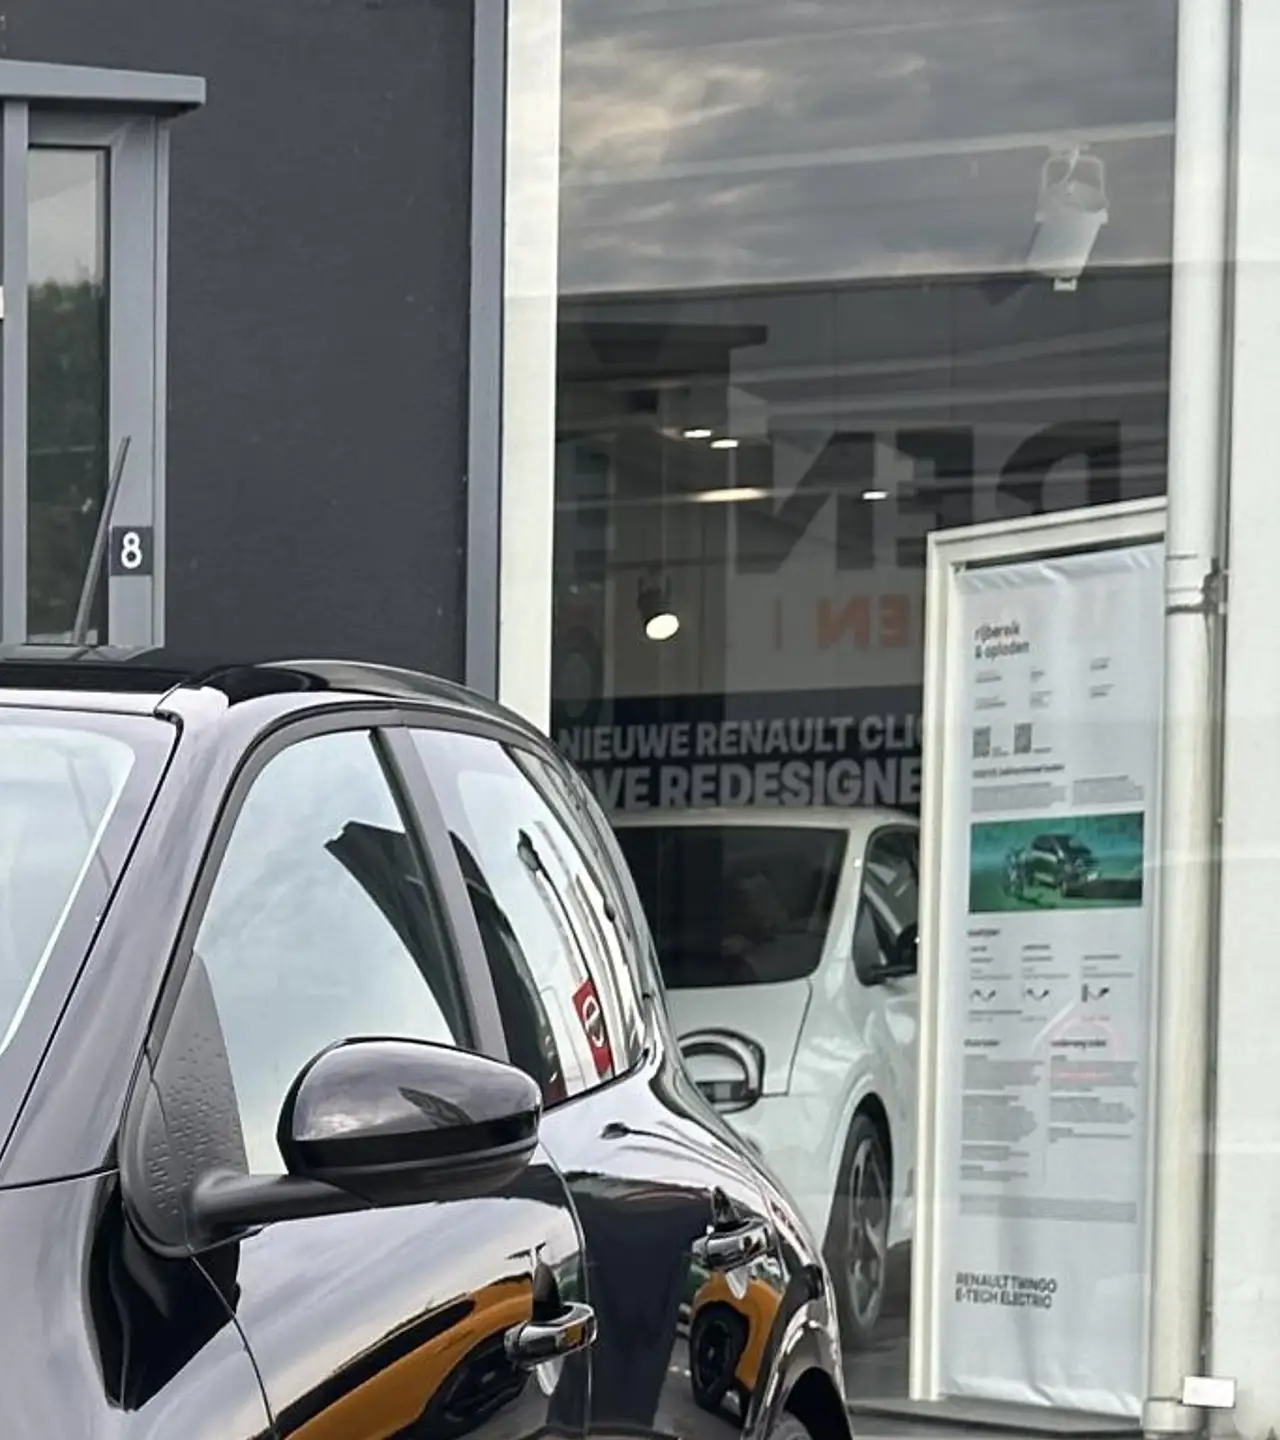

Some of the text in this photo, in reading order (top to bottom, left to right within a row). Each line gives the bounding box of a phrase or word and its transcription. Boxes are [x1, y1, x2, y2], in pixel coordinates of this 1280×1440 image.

[120, 531, 143, 569] 8
[559, 723, 690, 761] NIEUWE
[696, 716, 854, 758] RENAULT
[579, 765, 652, 813] VE
